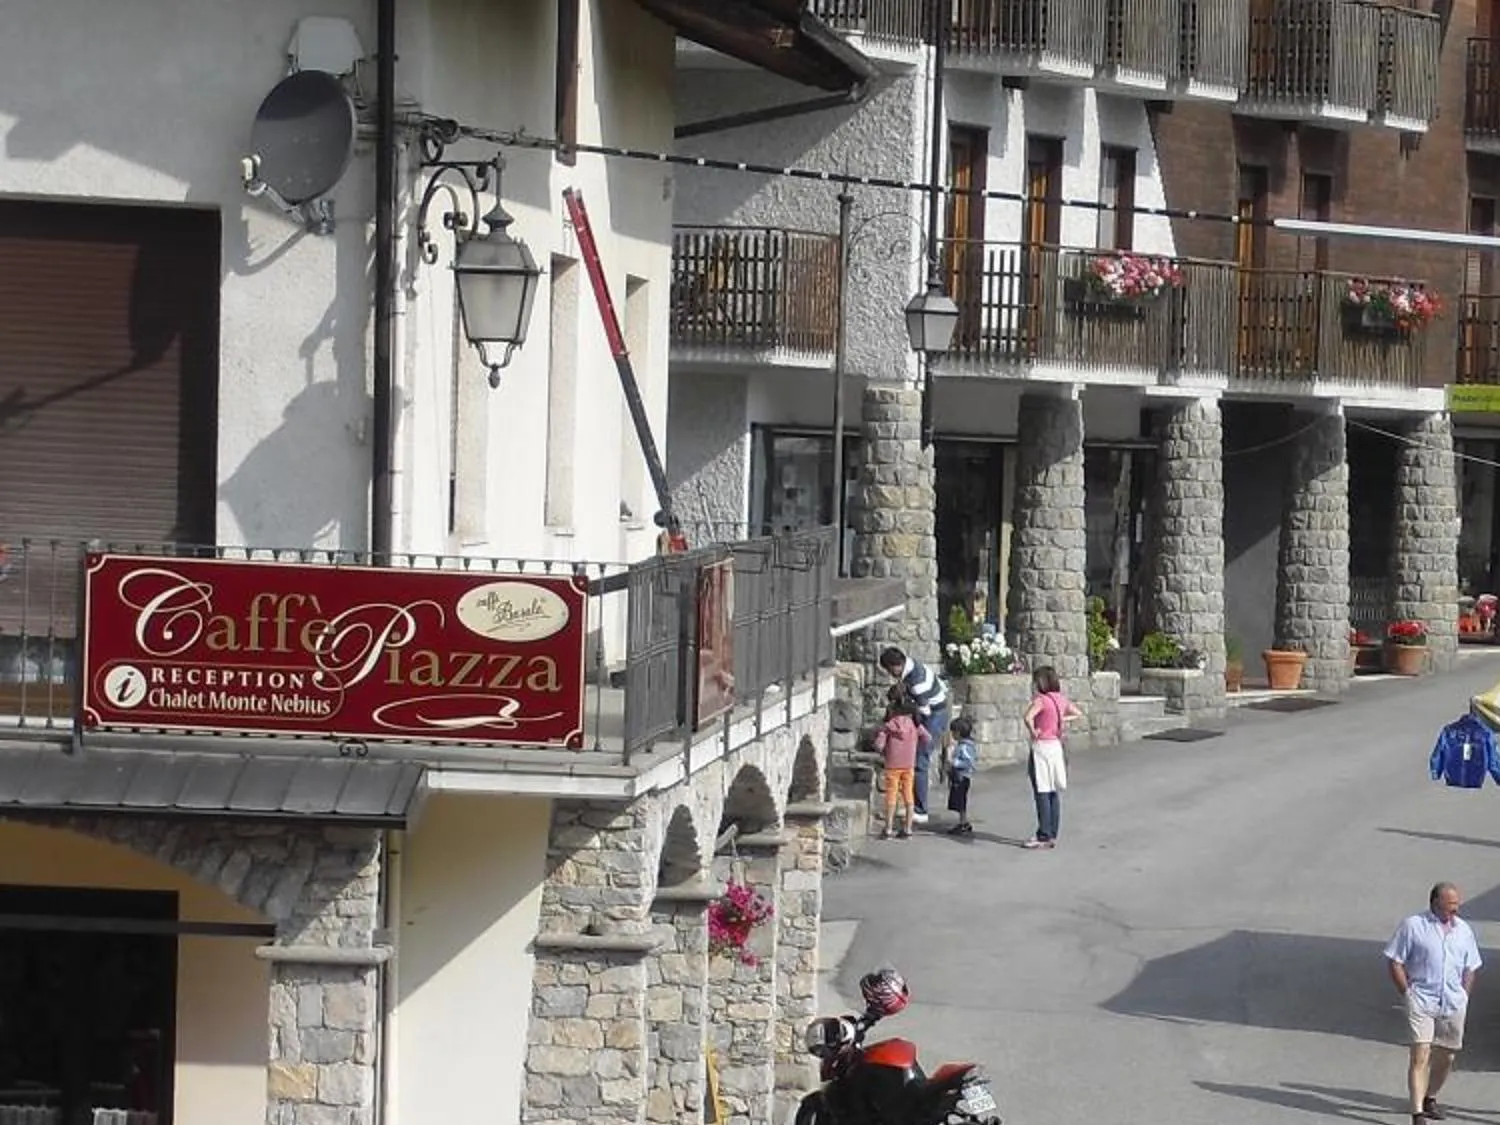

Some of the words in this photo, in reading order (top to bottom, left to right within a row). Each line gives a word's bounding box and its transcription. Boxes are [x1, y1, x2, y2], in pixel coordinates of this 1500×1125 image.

[117, 567, 337, 657] Caffè
[315, 599, 563, 692] Piazza
[151, 667, 305, 690] RECEPTION
[149, 688, 205, 712] Chalet
[208, 690, 267, 714] Monte
[270, 694, 332, 716] Nebius
